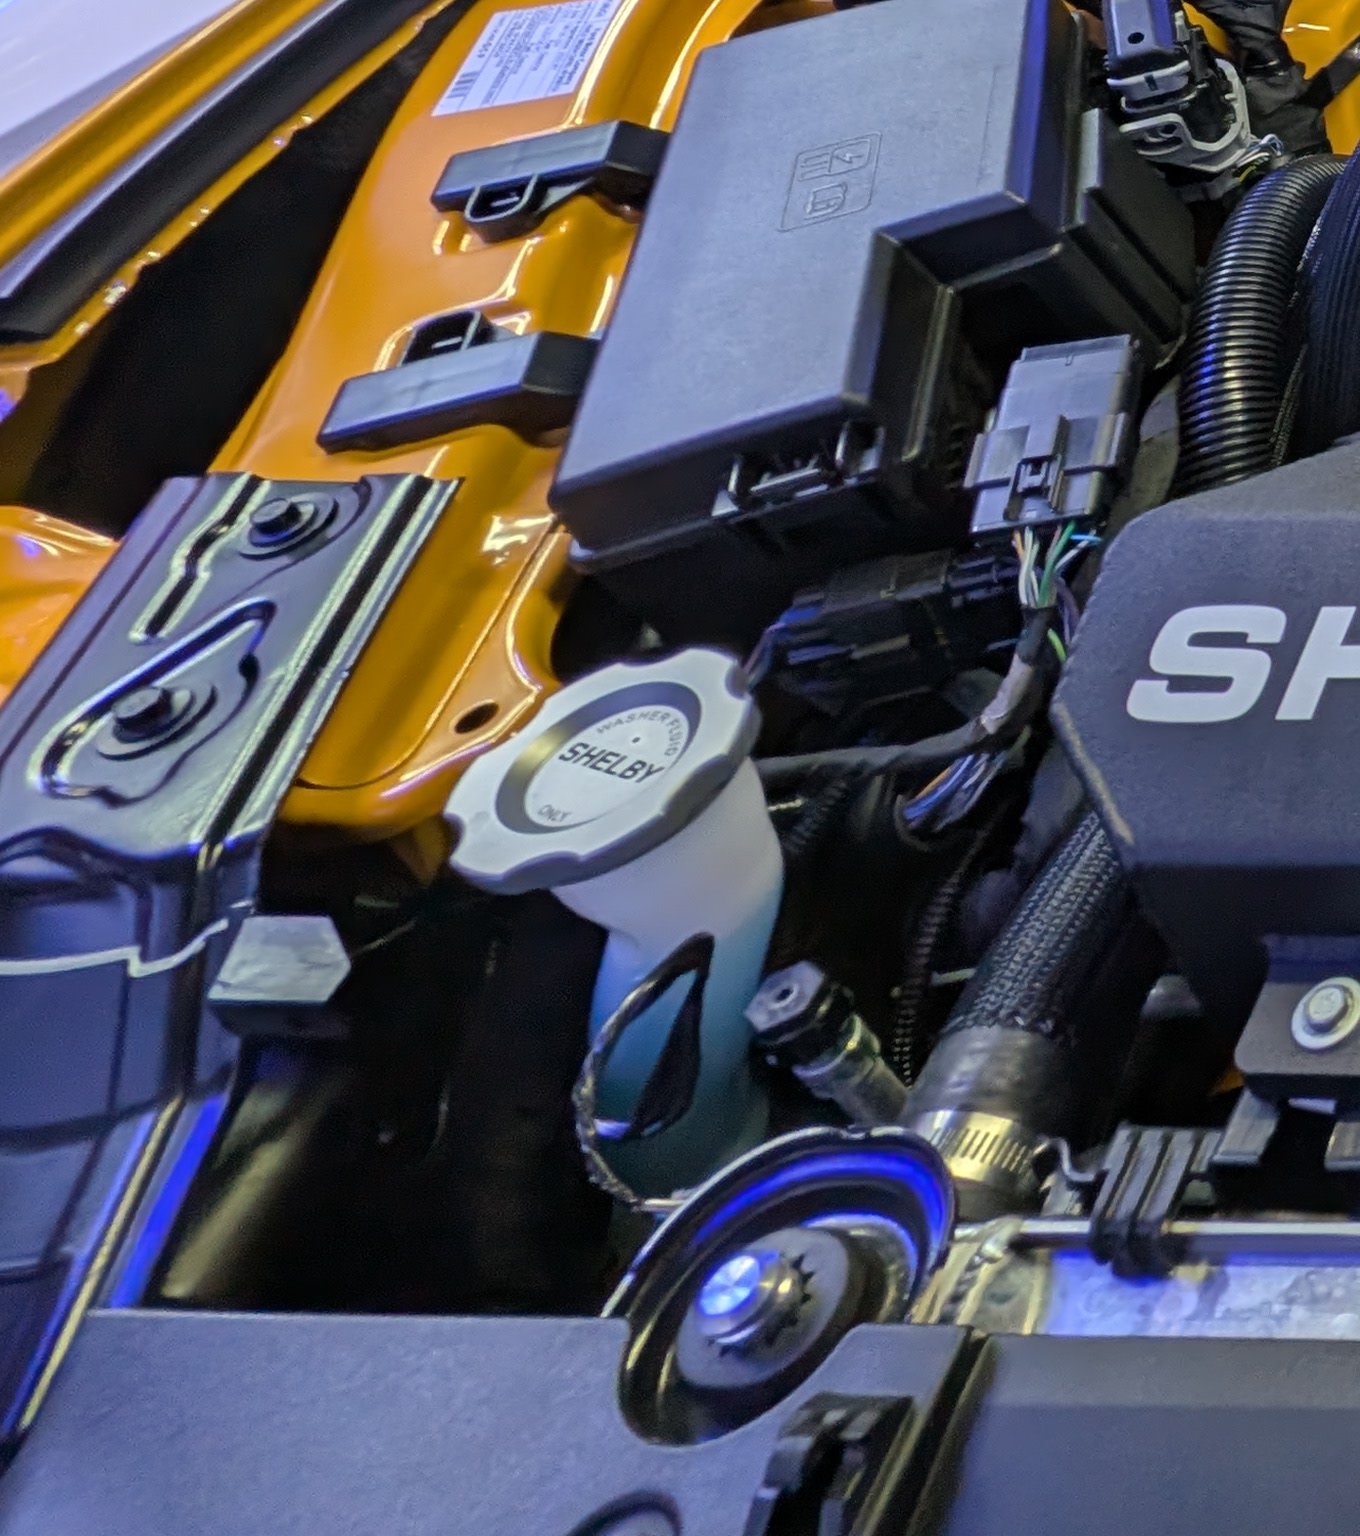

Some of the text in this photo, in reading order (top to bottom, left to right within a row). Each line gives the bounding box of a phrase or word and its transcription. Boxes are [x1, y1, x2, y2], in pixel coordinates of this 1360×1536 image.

[596, 710, 682, 757] WASHER FLUID
[558, 742, 665, 783] SHELBY
[537, 803, 572, 823] ONLY
